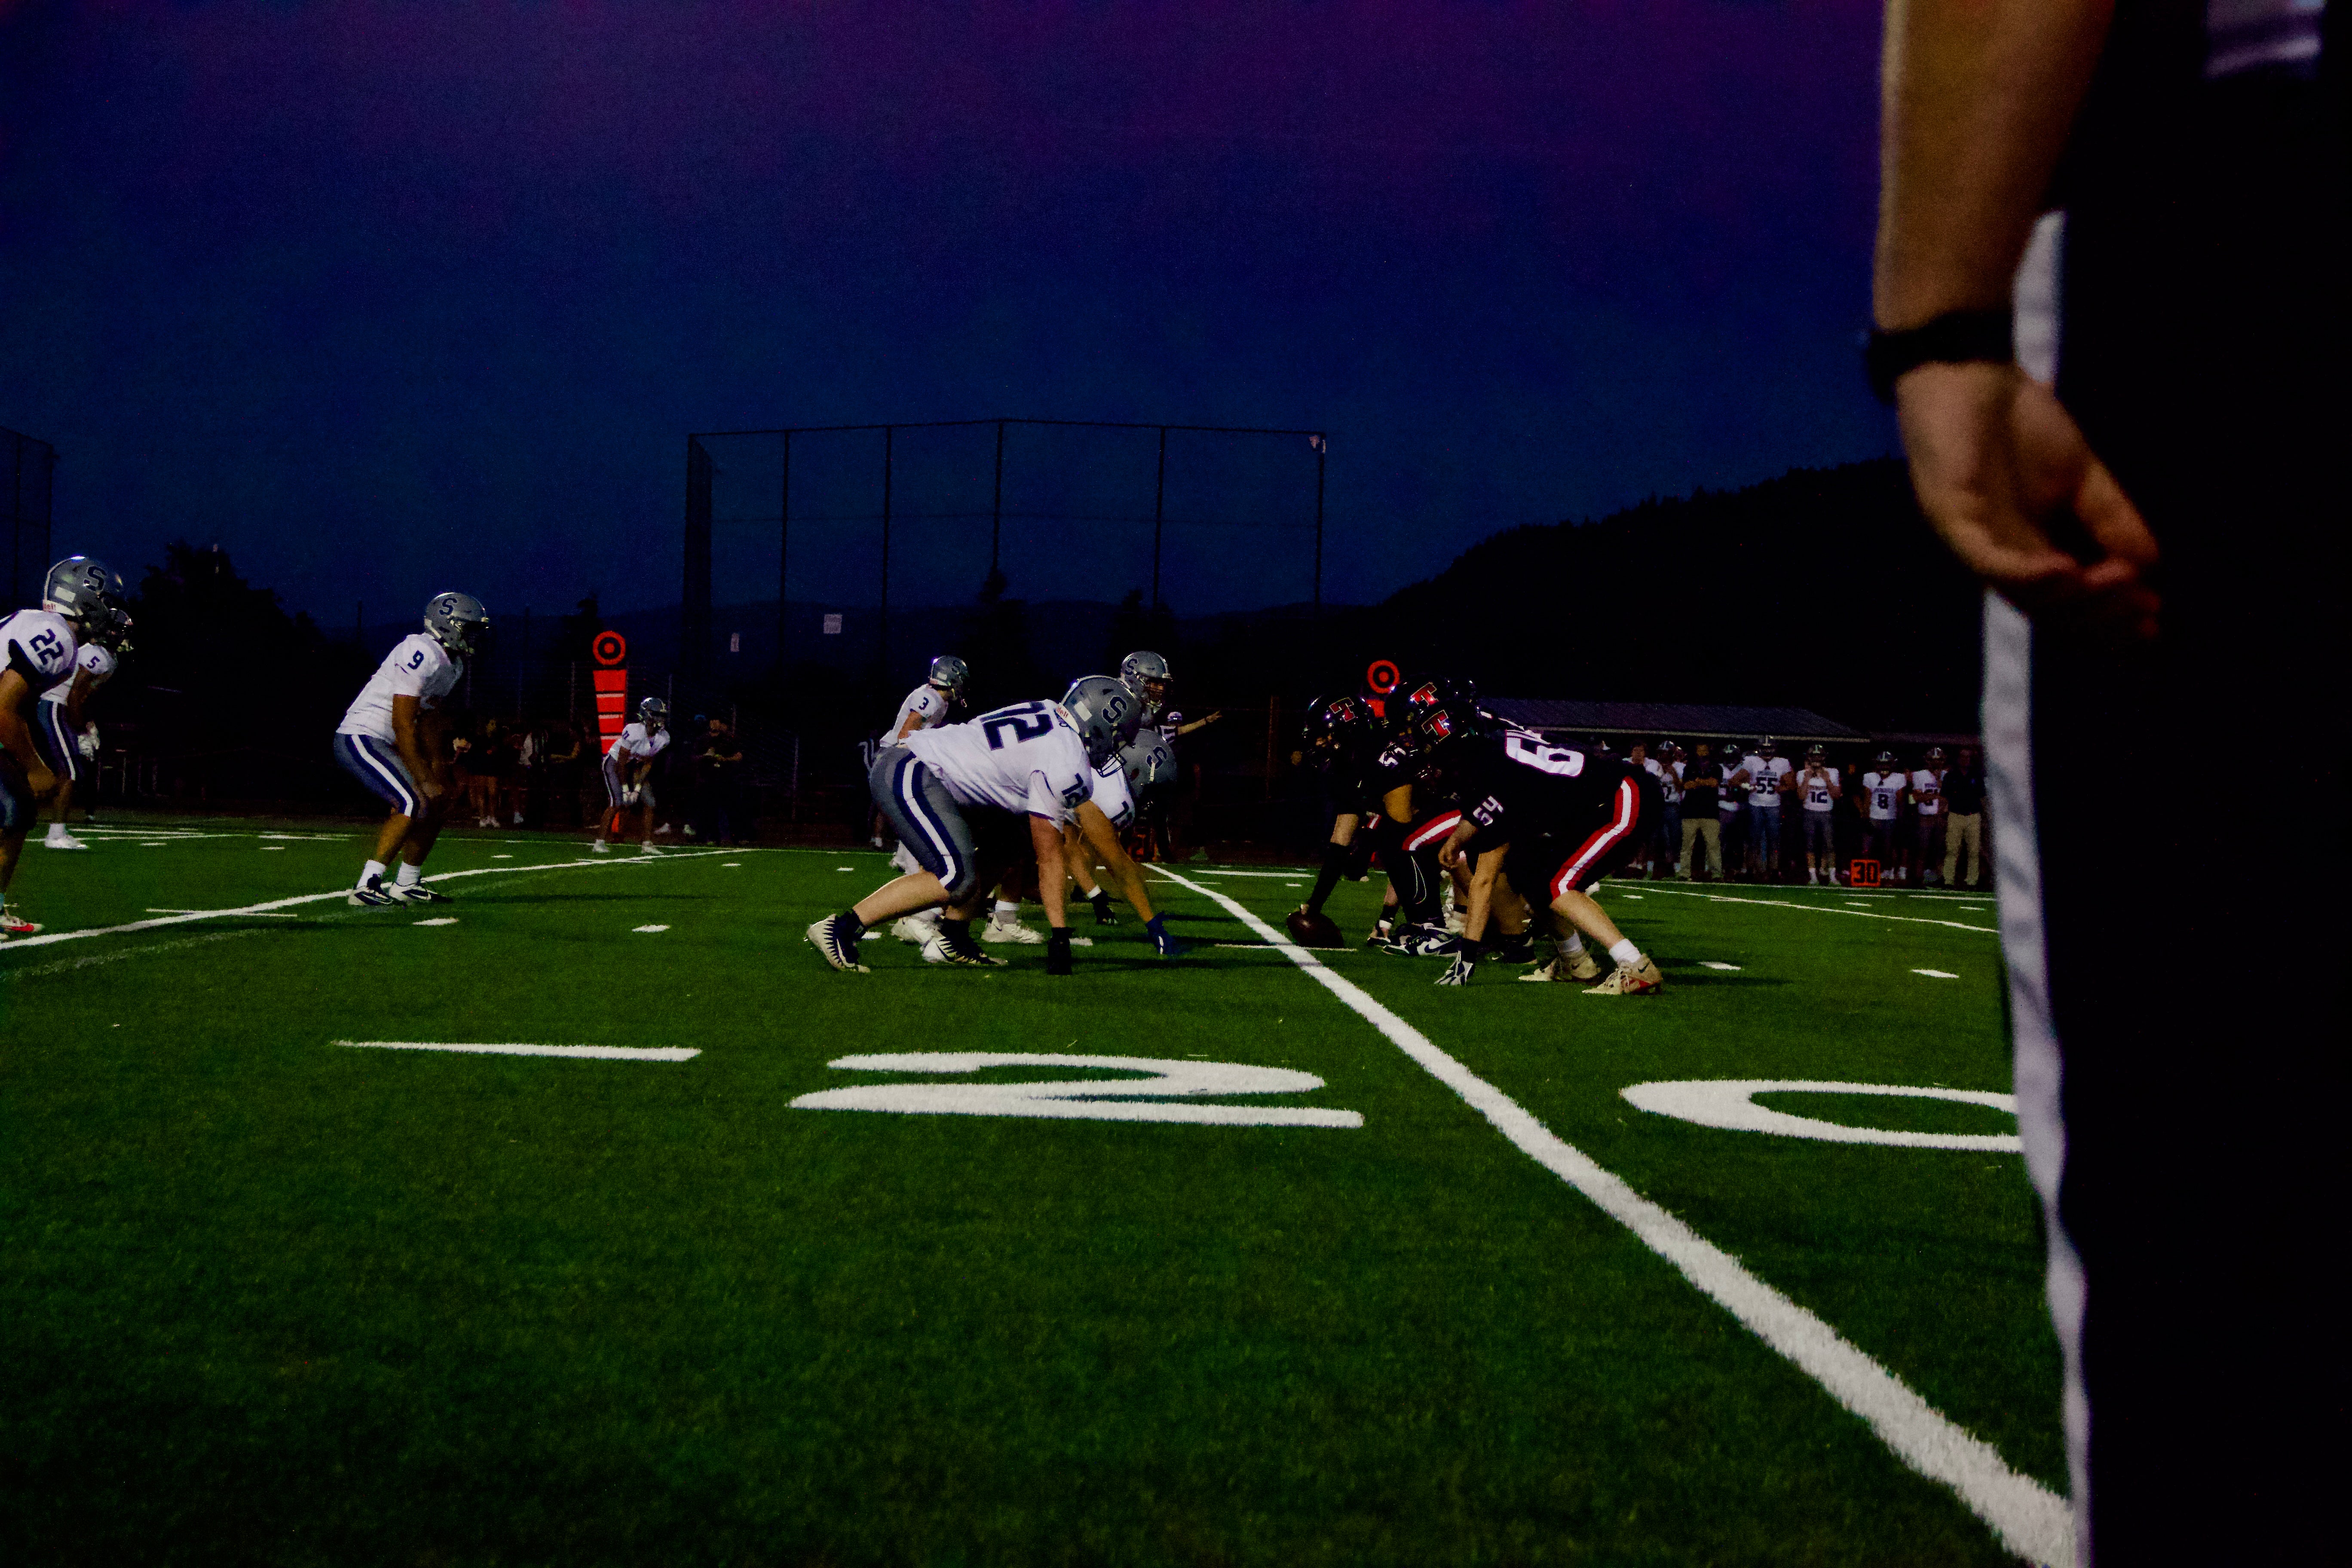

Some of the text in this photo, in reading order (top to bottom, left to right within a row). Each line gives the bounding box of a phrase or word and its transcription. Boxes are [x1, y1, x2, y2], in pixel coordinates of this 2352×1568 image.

[83, 565, 107, 592] S
[439, 597, 457, 616] S
[29, 628, 64, 665] 22
[407, 649, 424, 670] 9
[86, 655, 101, 669] 5
[918, 696, 930, 710] 3
[1411, 681, 1439, 707] T
[1102, 696, 1127, 724] S
[1329, 696, 1356, 723] T
[1421, 709, 1451, 742] T
[1146, 746, 1167, 770] S
[1061, 772, 1089, 809] 72
[1756, 777, 1778, 795] 55
[1473, 795, 1504, 826] 54
[1877, 793, 1889, 809] 8
[1853, 862, 1878, 883] 30
[784, 1051, 1364, 1129] 2
